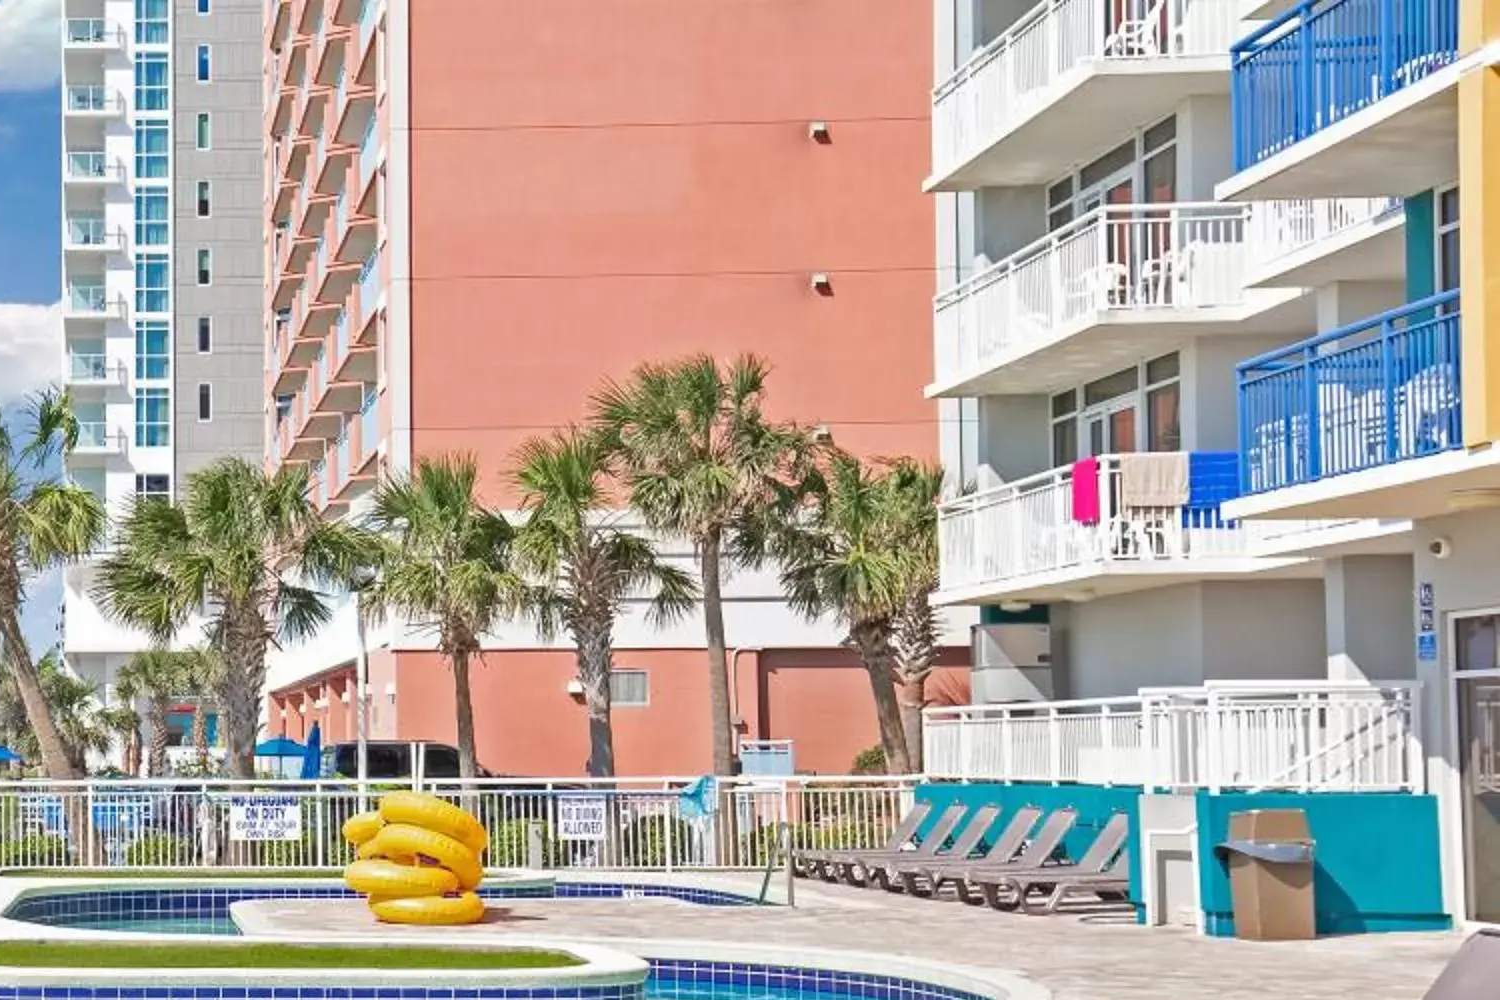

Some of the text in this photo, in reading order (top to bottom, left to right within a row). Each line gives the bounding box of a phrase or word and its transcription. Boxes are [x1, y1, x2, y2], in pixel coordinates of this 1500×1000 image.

[246, 807, 286, 820] ON DUTY
[575, 807, 603, 821] DIVING
[563, 821, 603, 835] ALLOWED
